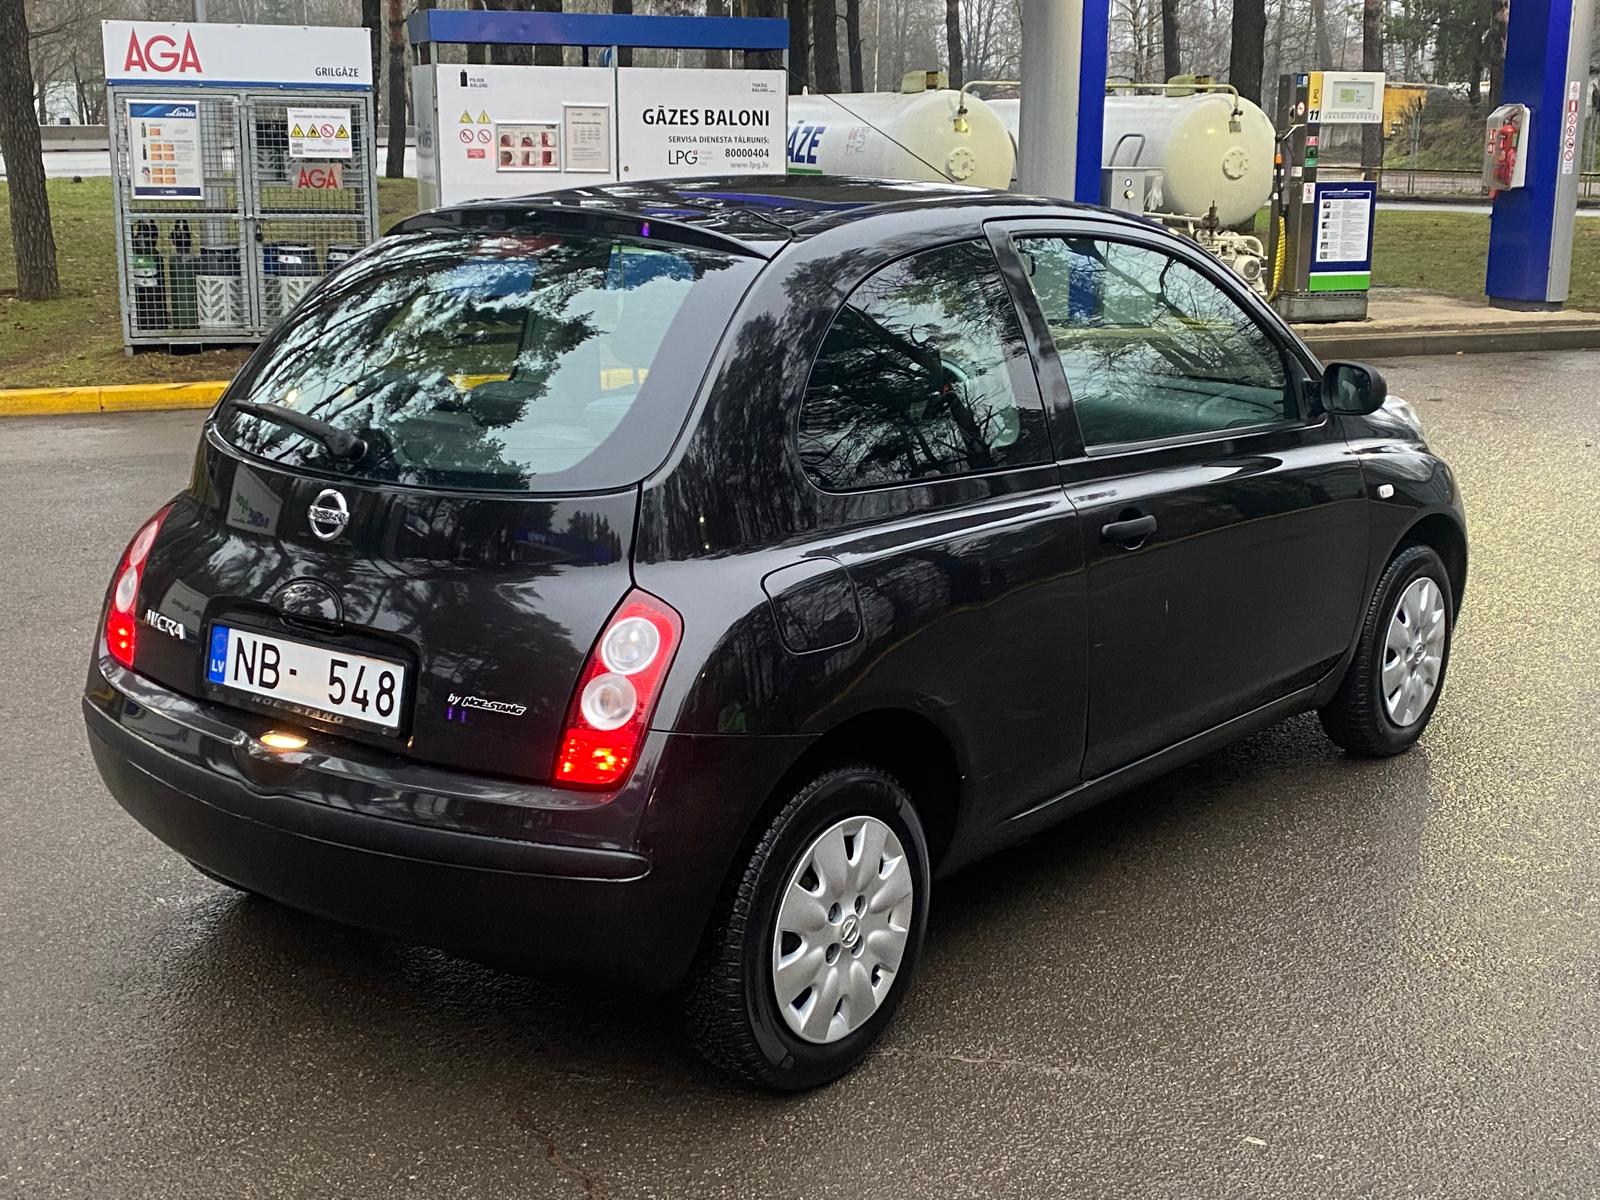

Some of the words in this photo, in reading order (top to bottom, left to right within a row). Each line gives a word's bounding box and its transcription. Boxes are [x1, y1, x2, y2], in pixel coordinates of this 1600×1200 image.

[124, 27, 203, 73] AGA
[315, 66, 359, 78] GRILGĀZE
[642, 105, 699, 126] GĀZES
[704, 109, 770, 127] BALONI
[1309, 109, 1320, 121] 11
[668, 135, 698, 144] SERVISA
[699, 136, 733, 145] DIENESTA
[734, 135, 770, 145] TĀLRUNIS:
[668, 149, 698, 165] LPG
[725, 148, 769, 158] 80000404
[730, 160, 769, 170] www.lpg.lv
[298, 164, 338, 189] AGA
[144, 609, 186, 640] MICRA
[211, 658, 226, 673] LV
[328, 658, 396, 718] 548
[447, 692, 462, 706] by
